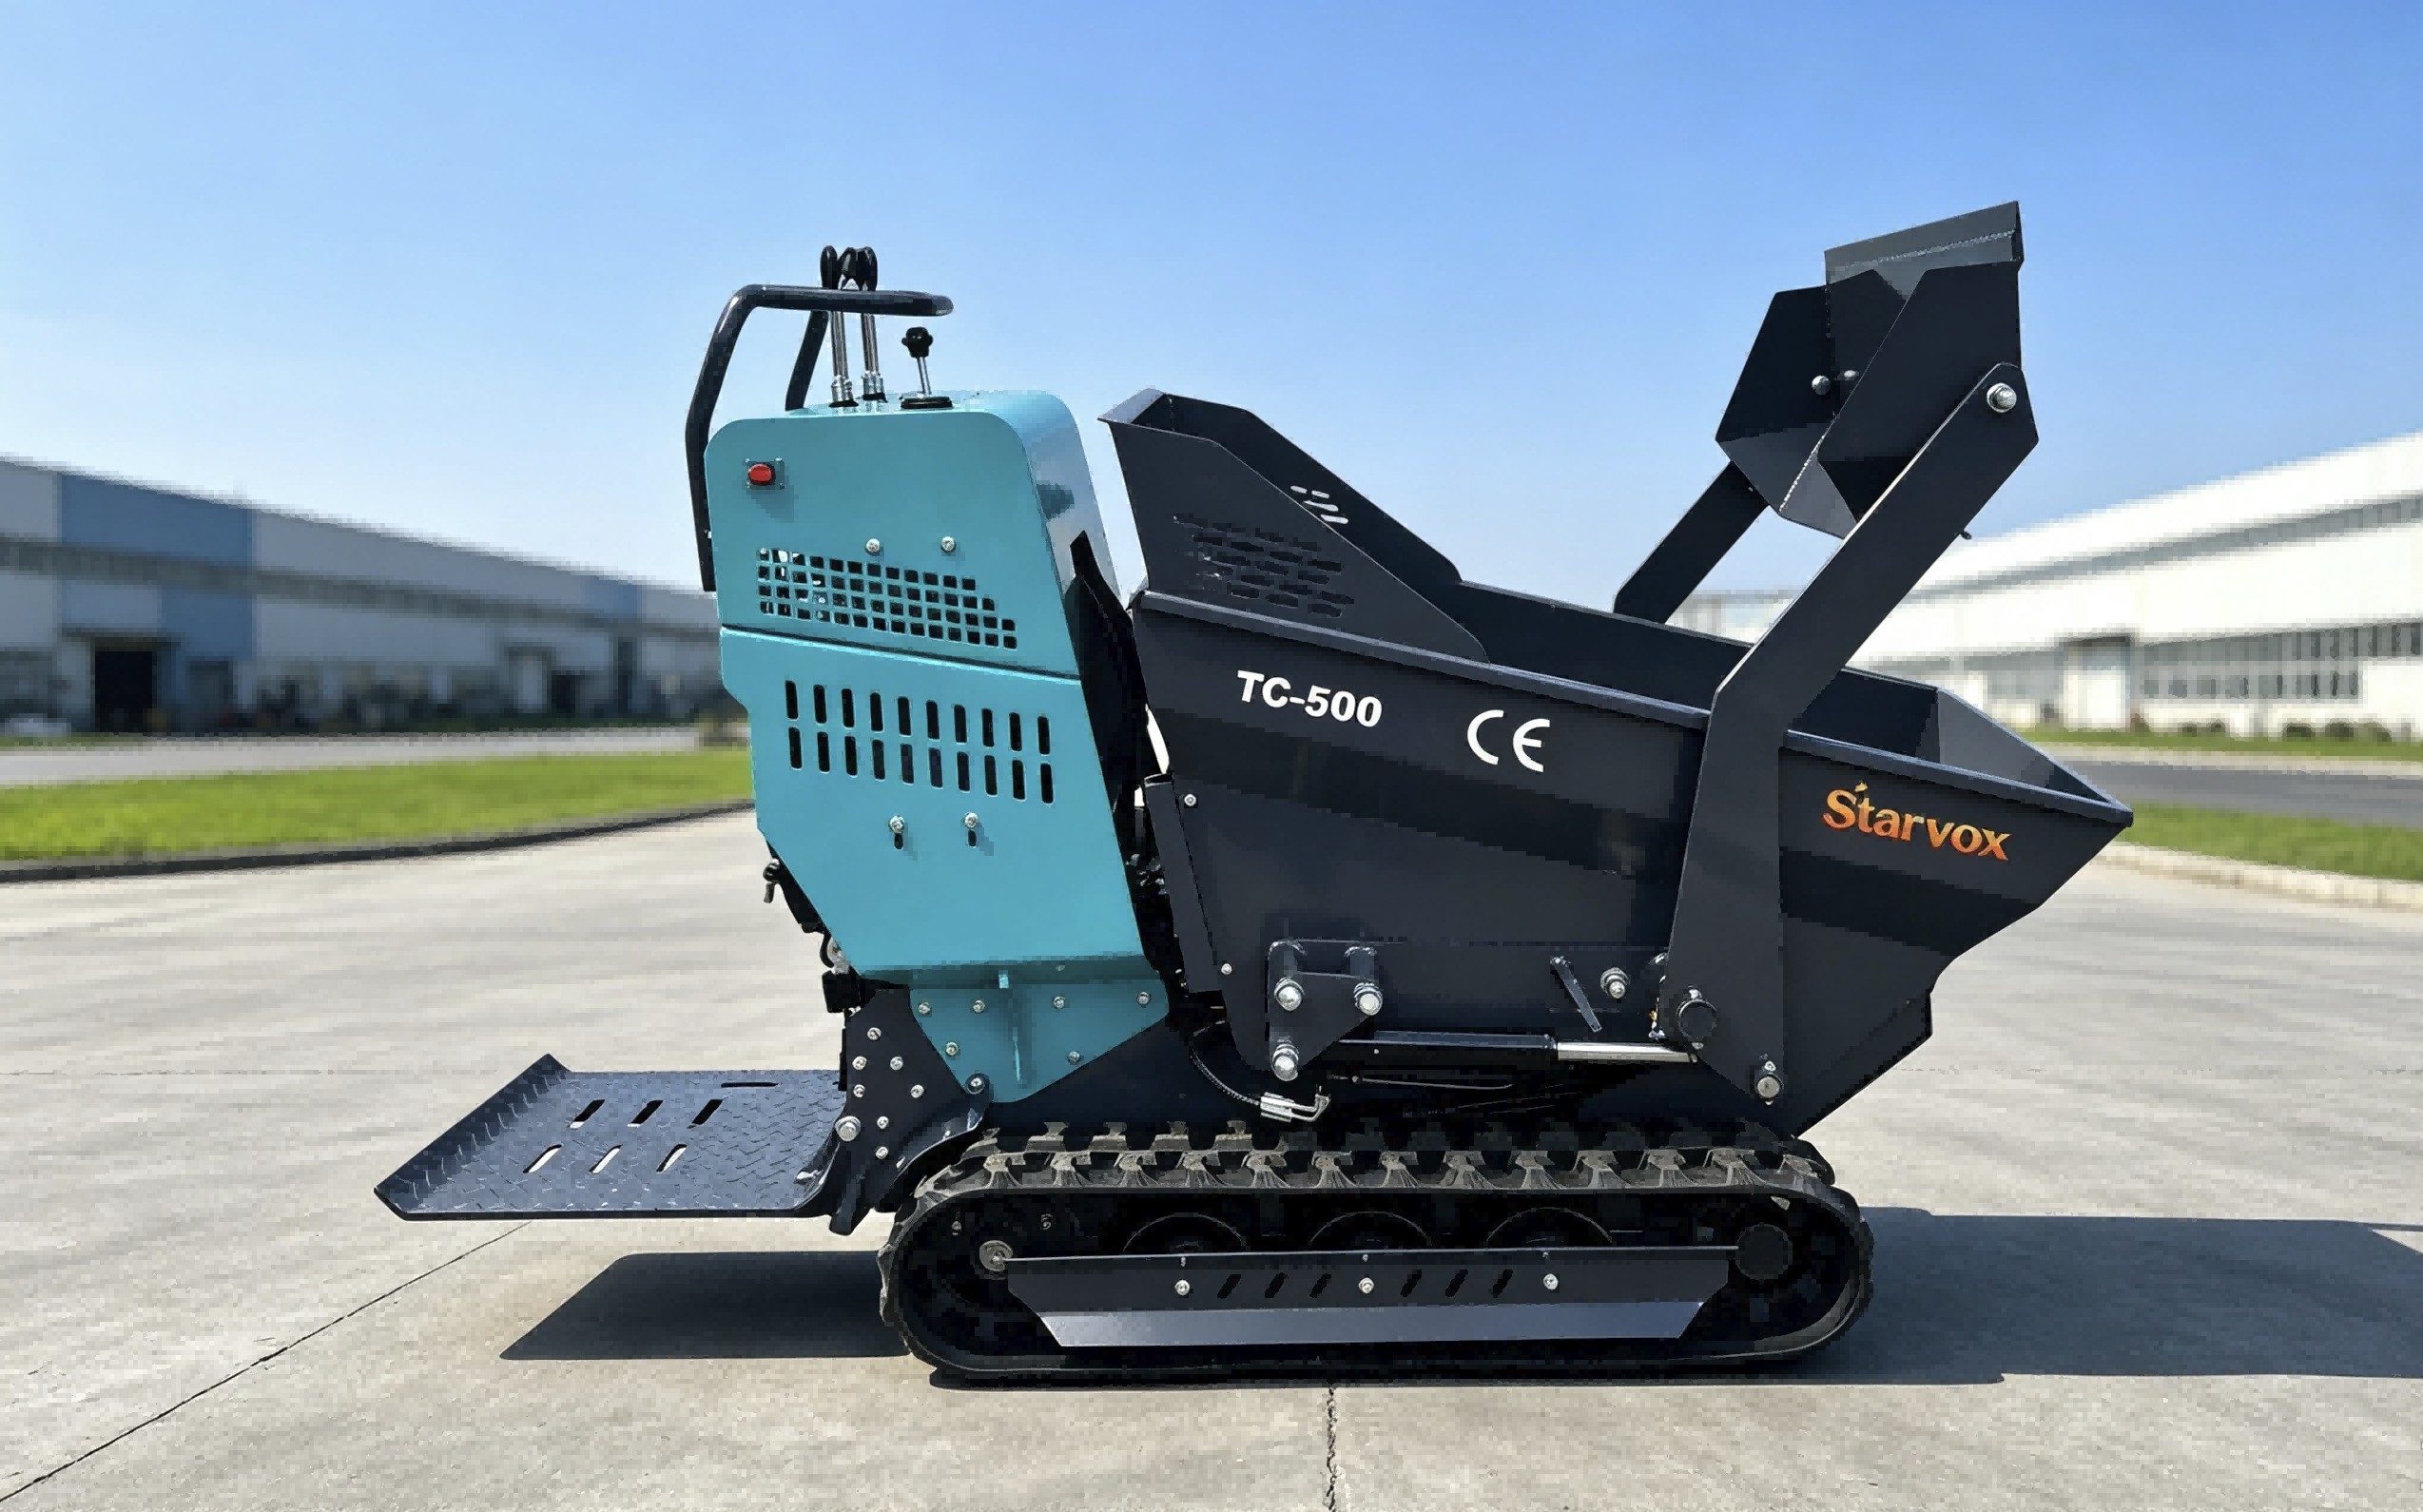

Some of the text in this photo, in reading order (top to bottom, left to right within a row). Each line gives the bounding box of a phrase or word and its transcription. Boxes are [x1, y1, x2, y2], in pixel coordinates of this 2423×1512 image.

[1237, 669, 1383, 727] TC-500
[1466, 708, 1551, 773] CE
[1822, 783, 2011, 862] Starvox
